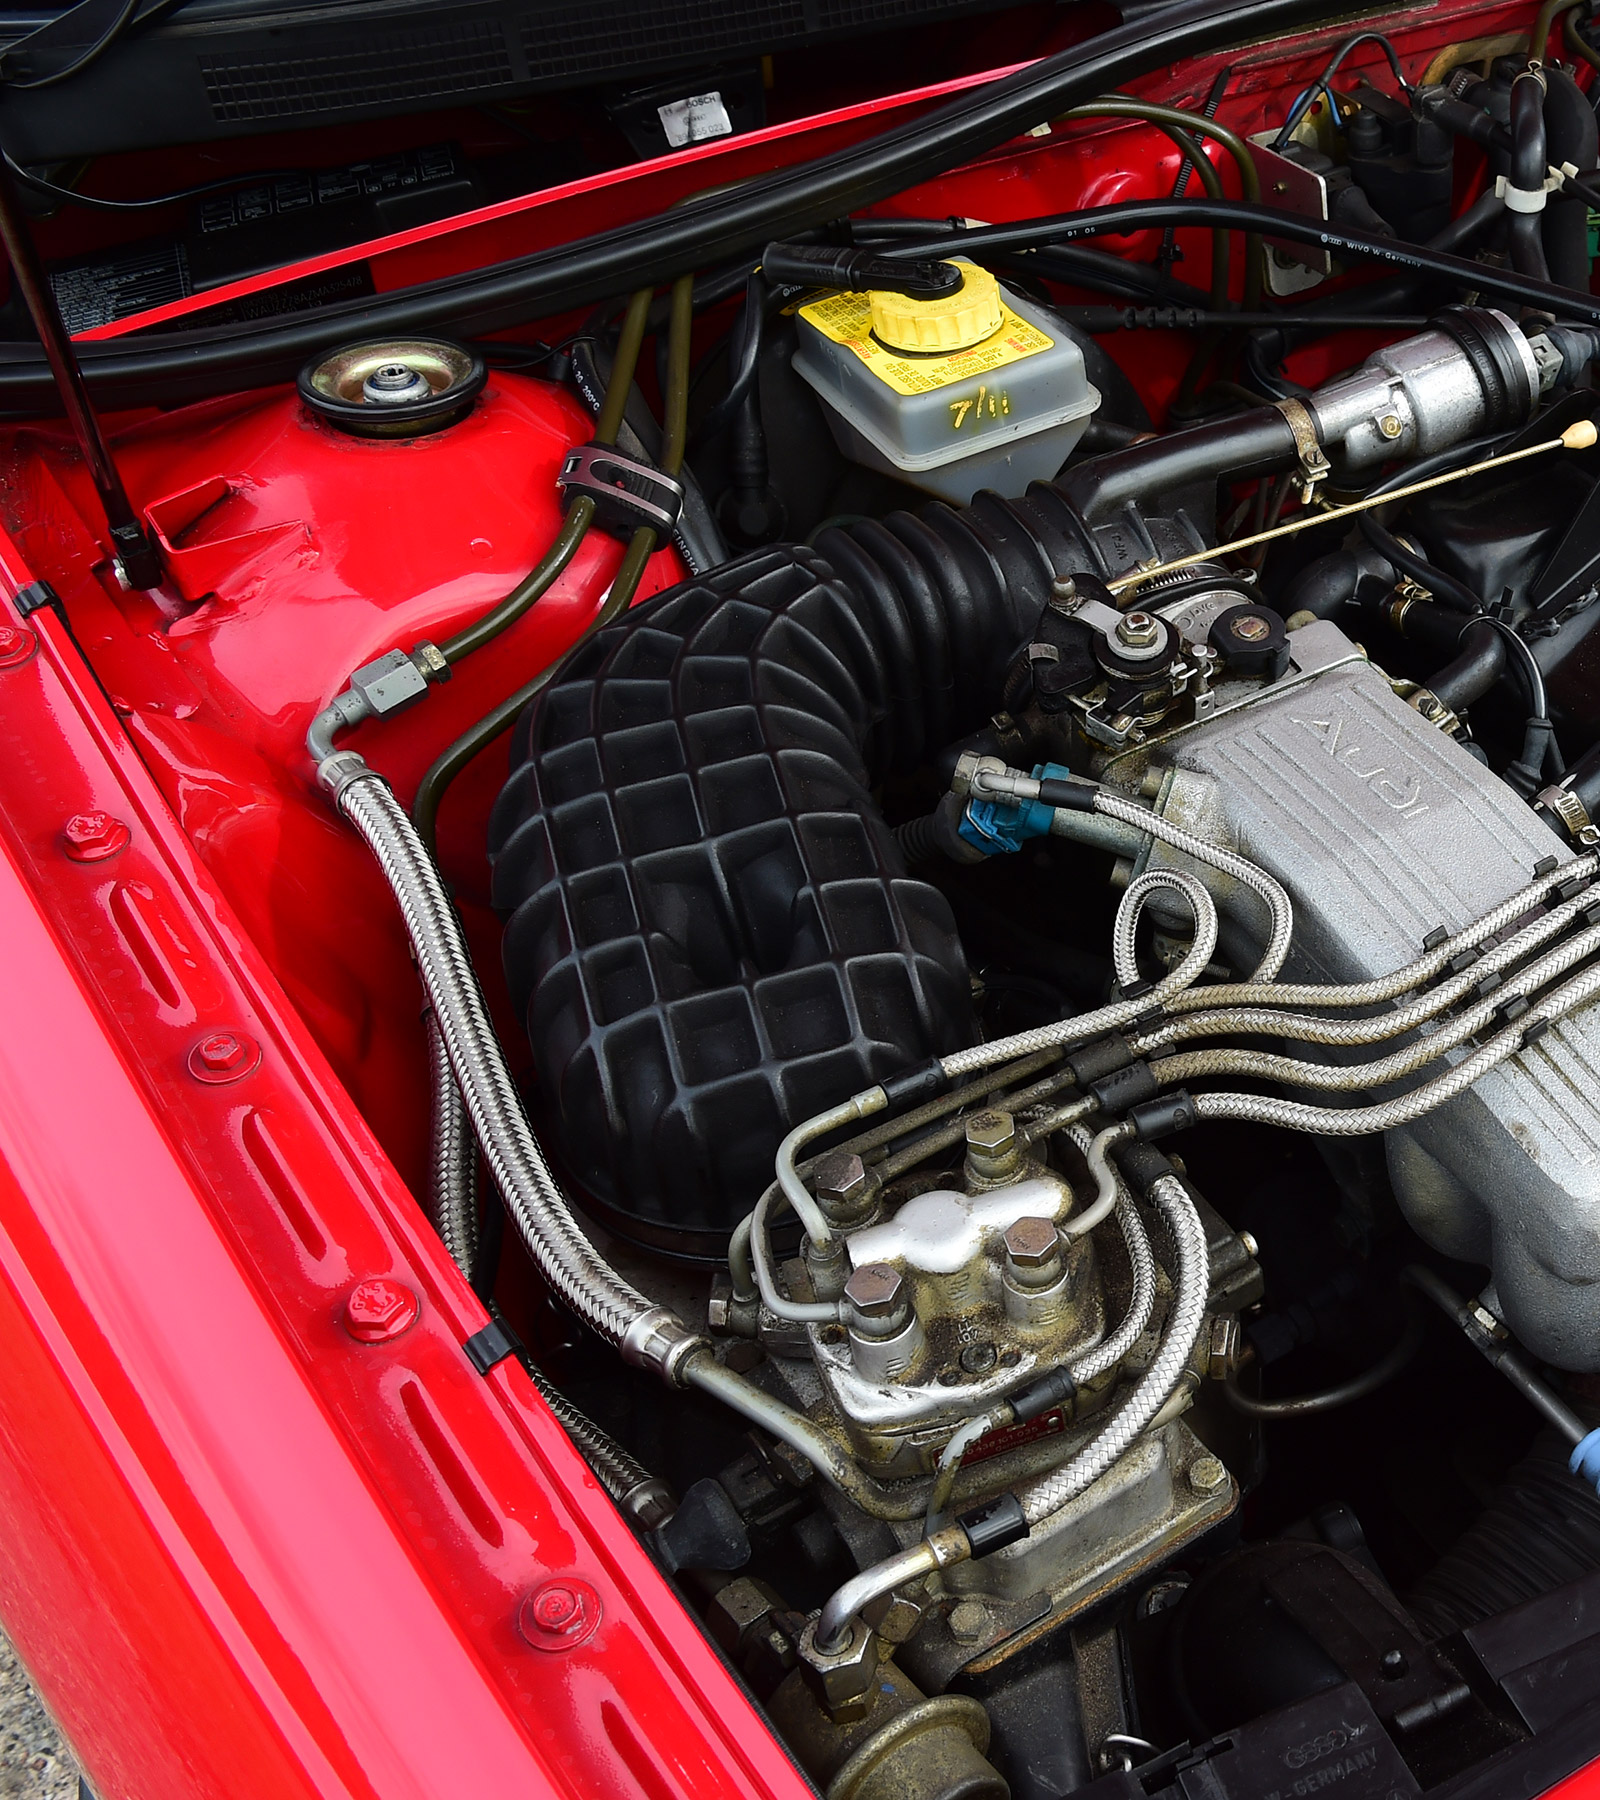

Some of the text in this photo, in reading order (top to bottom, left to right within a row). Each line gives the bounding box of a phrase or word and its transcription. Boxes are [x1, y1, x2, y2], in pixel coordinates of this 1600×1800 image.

[685, 95, 716, 109] BOSCH
[1346, 241, 1370, 253] WIVO
[1285, 715, 1431, 820] AUDI
